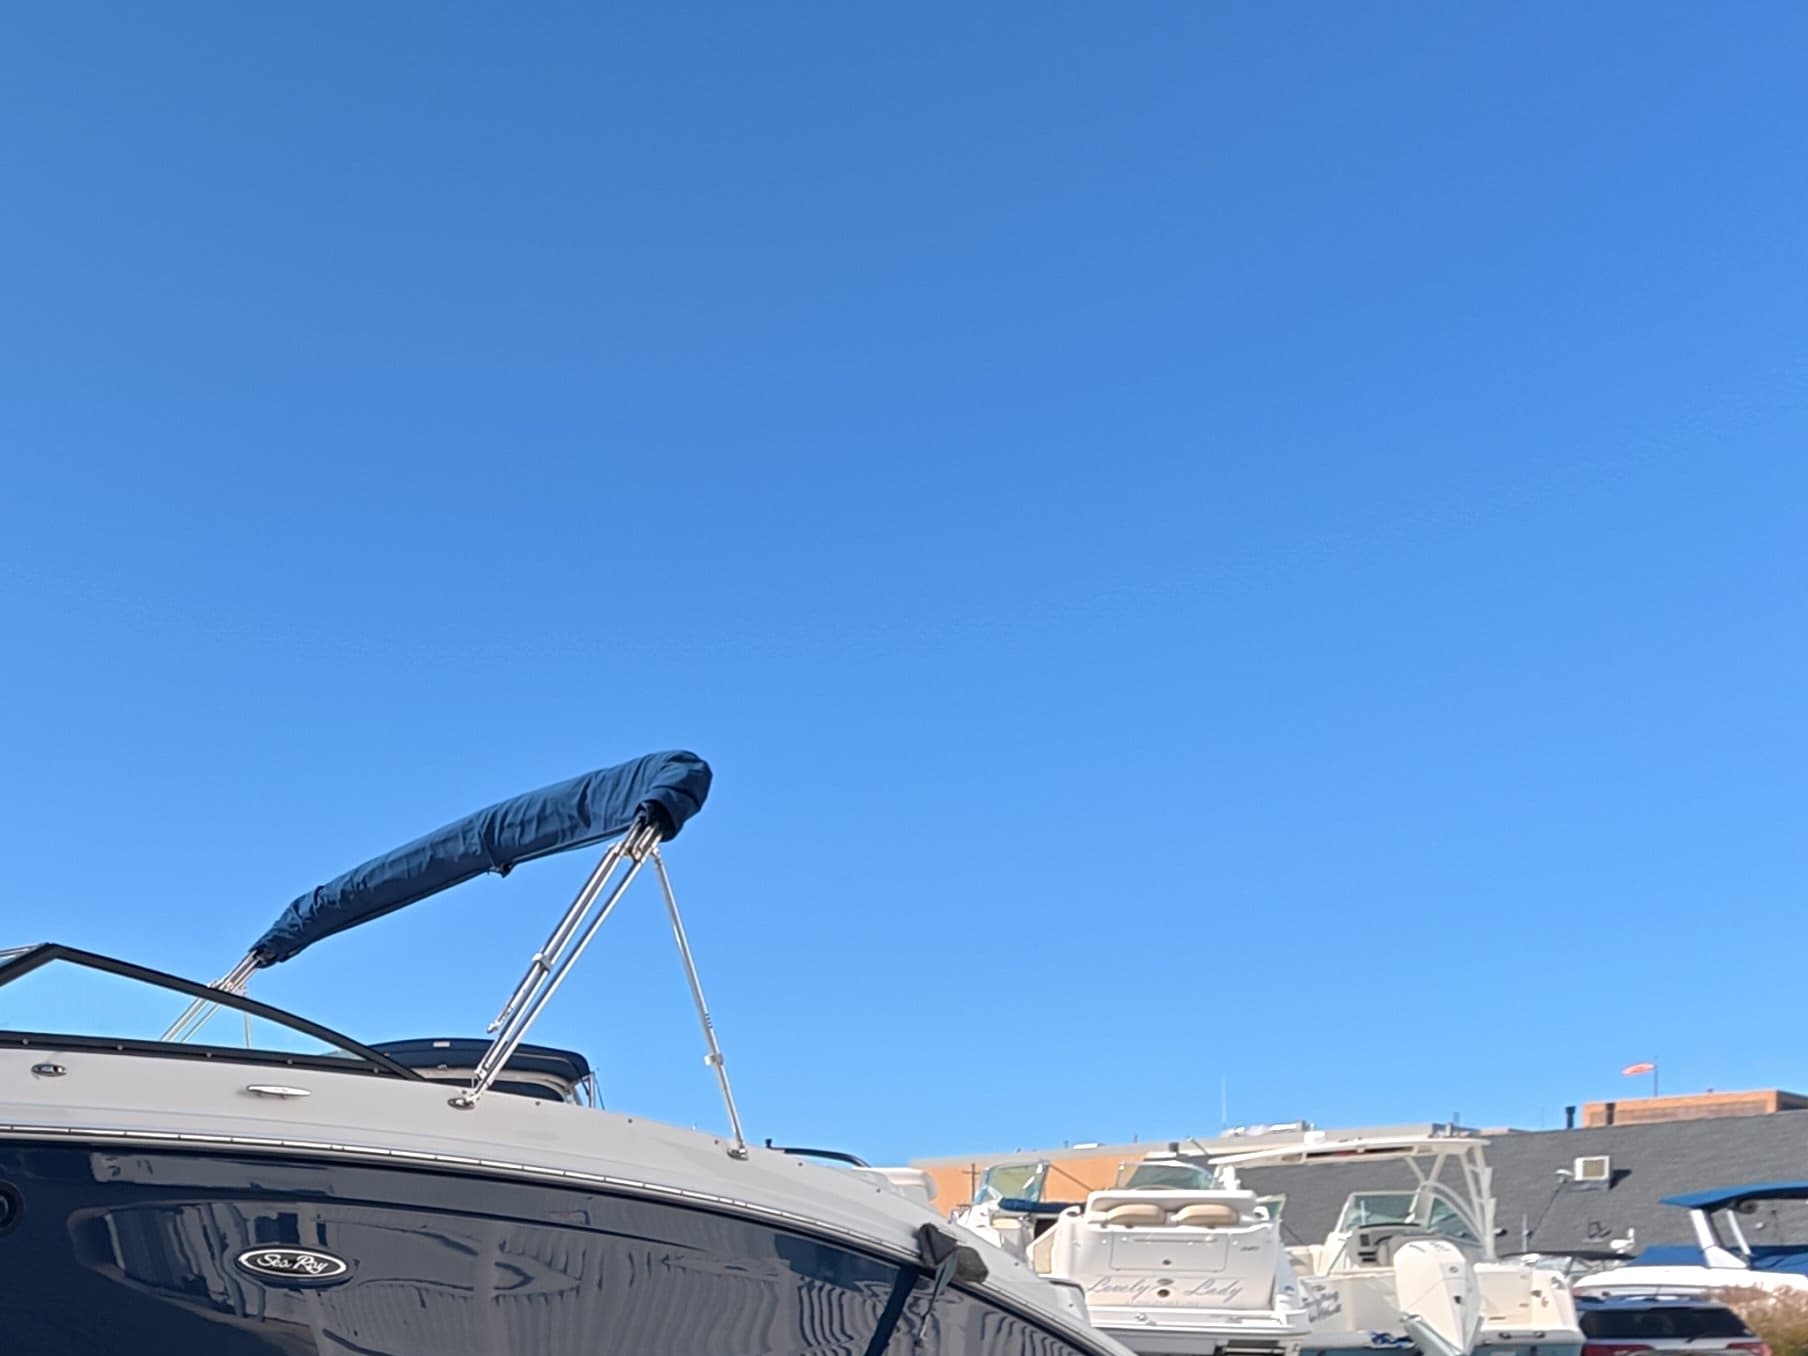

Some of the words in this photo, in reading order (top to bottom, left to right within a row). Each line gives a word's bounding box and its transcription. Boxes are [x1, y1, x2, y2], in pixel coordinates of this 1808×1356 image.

[256, 1253, 293, 1269] Sea
[293, 1254, 329, 1274] Ray
[1185, 1278, 1244, 1302] Lady
